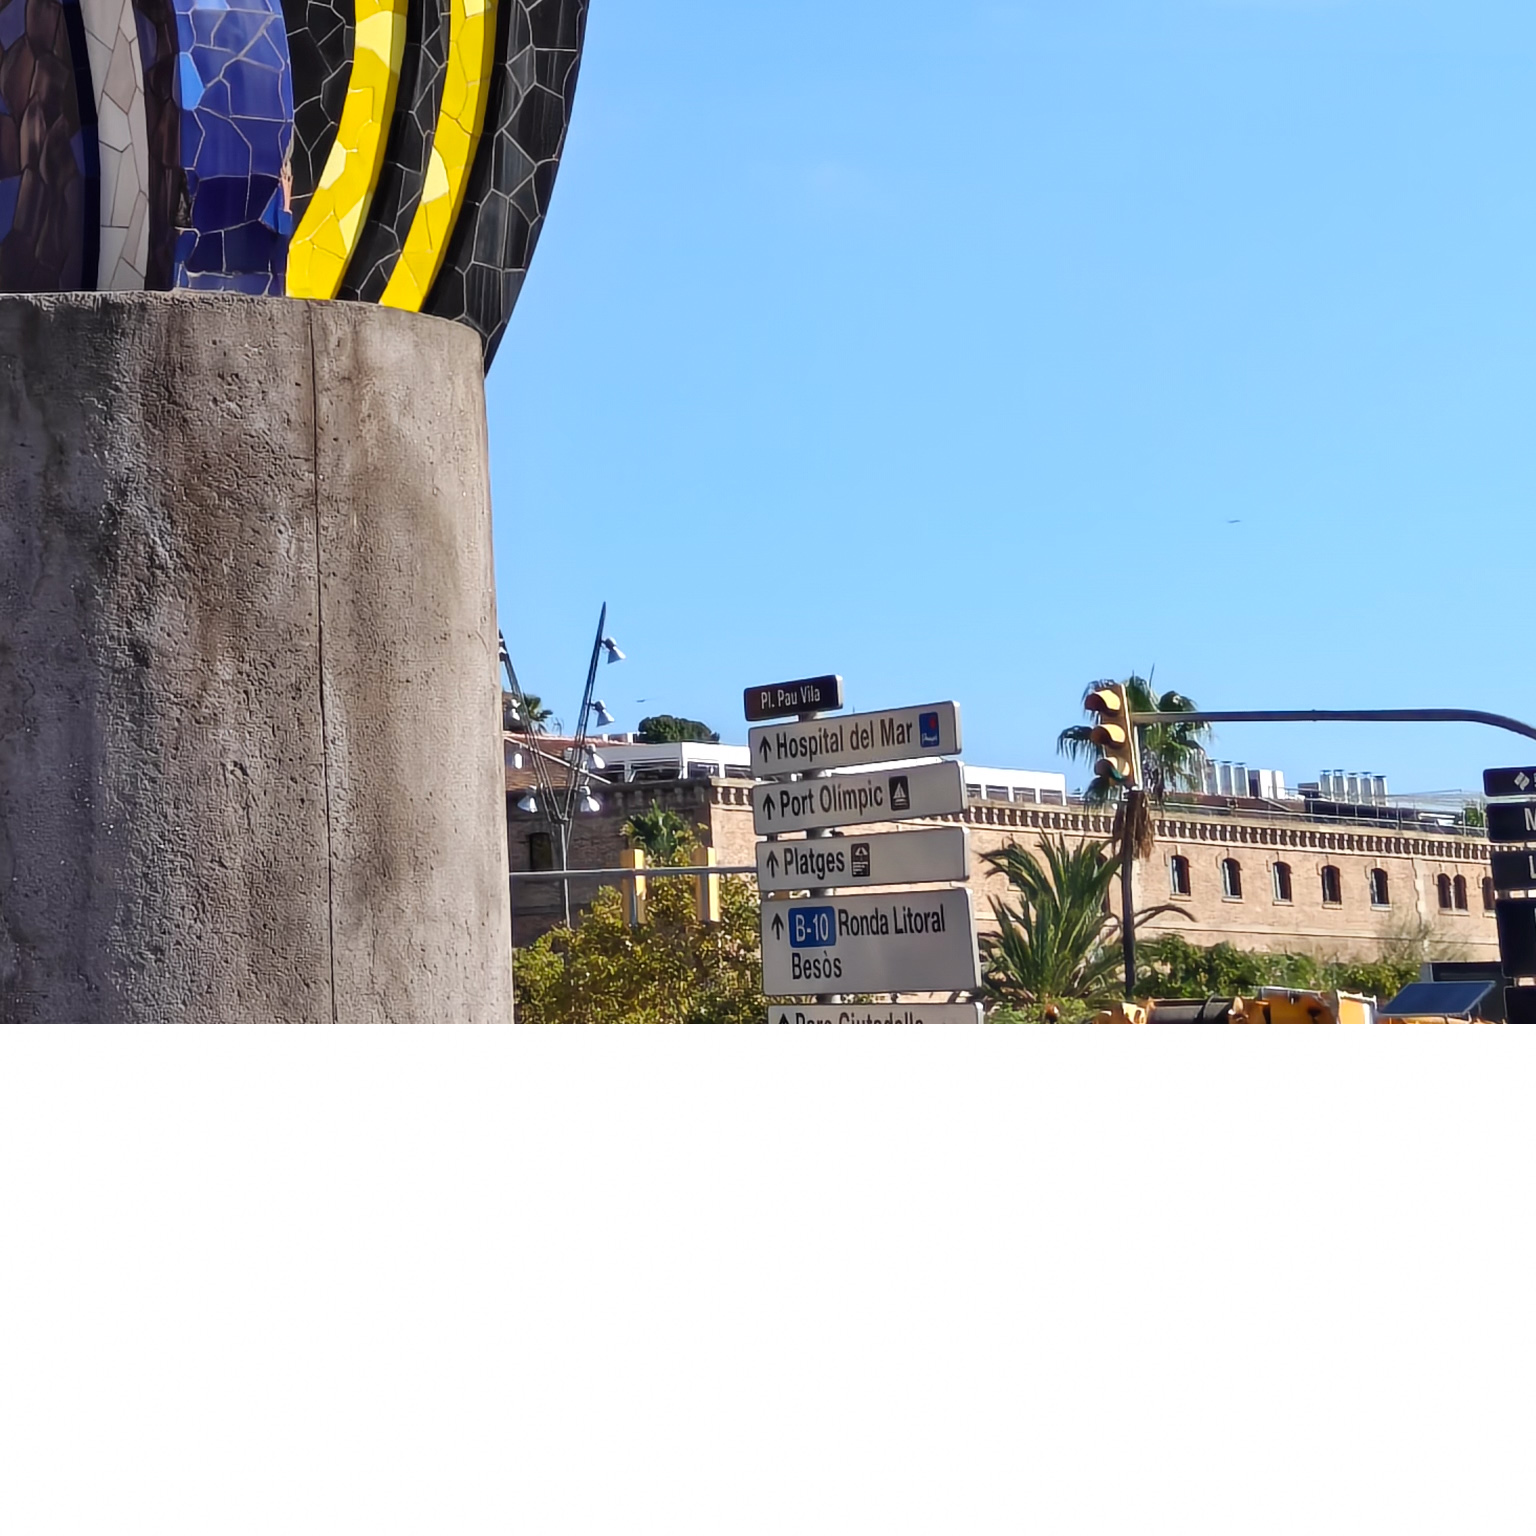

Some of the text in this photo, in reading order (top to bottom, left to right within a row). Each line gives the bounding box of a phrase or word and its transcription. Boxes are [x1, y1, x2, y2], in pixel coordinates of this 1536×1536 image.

[761, 685, 821, 709] Pl. Pau Vila
[776, 718, 913, 762] Hospital del Mar
[779, 780, 883, 818] Port Olímpic
[784, 847, 845, 880] Platges
[795, 904, 946, 942] B-10 Ronda Litoral
[791, 950, 842, 980] Besòs
